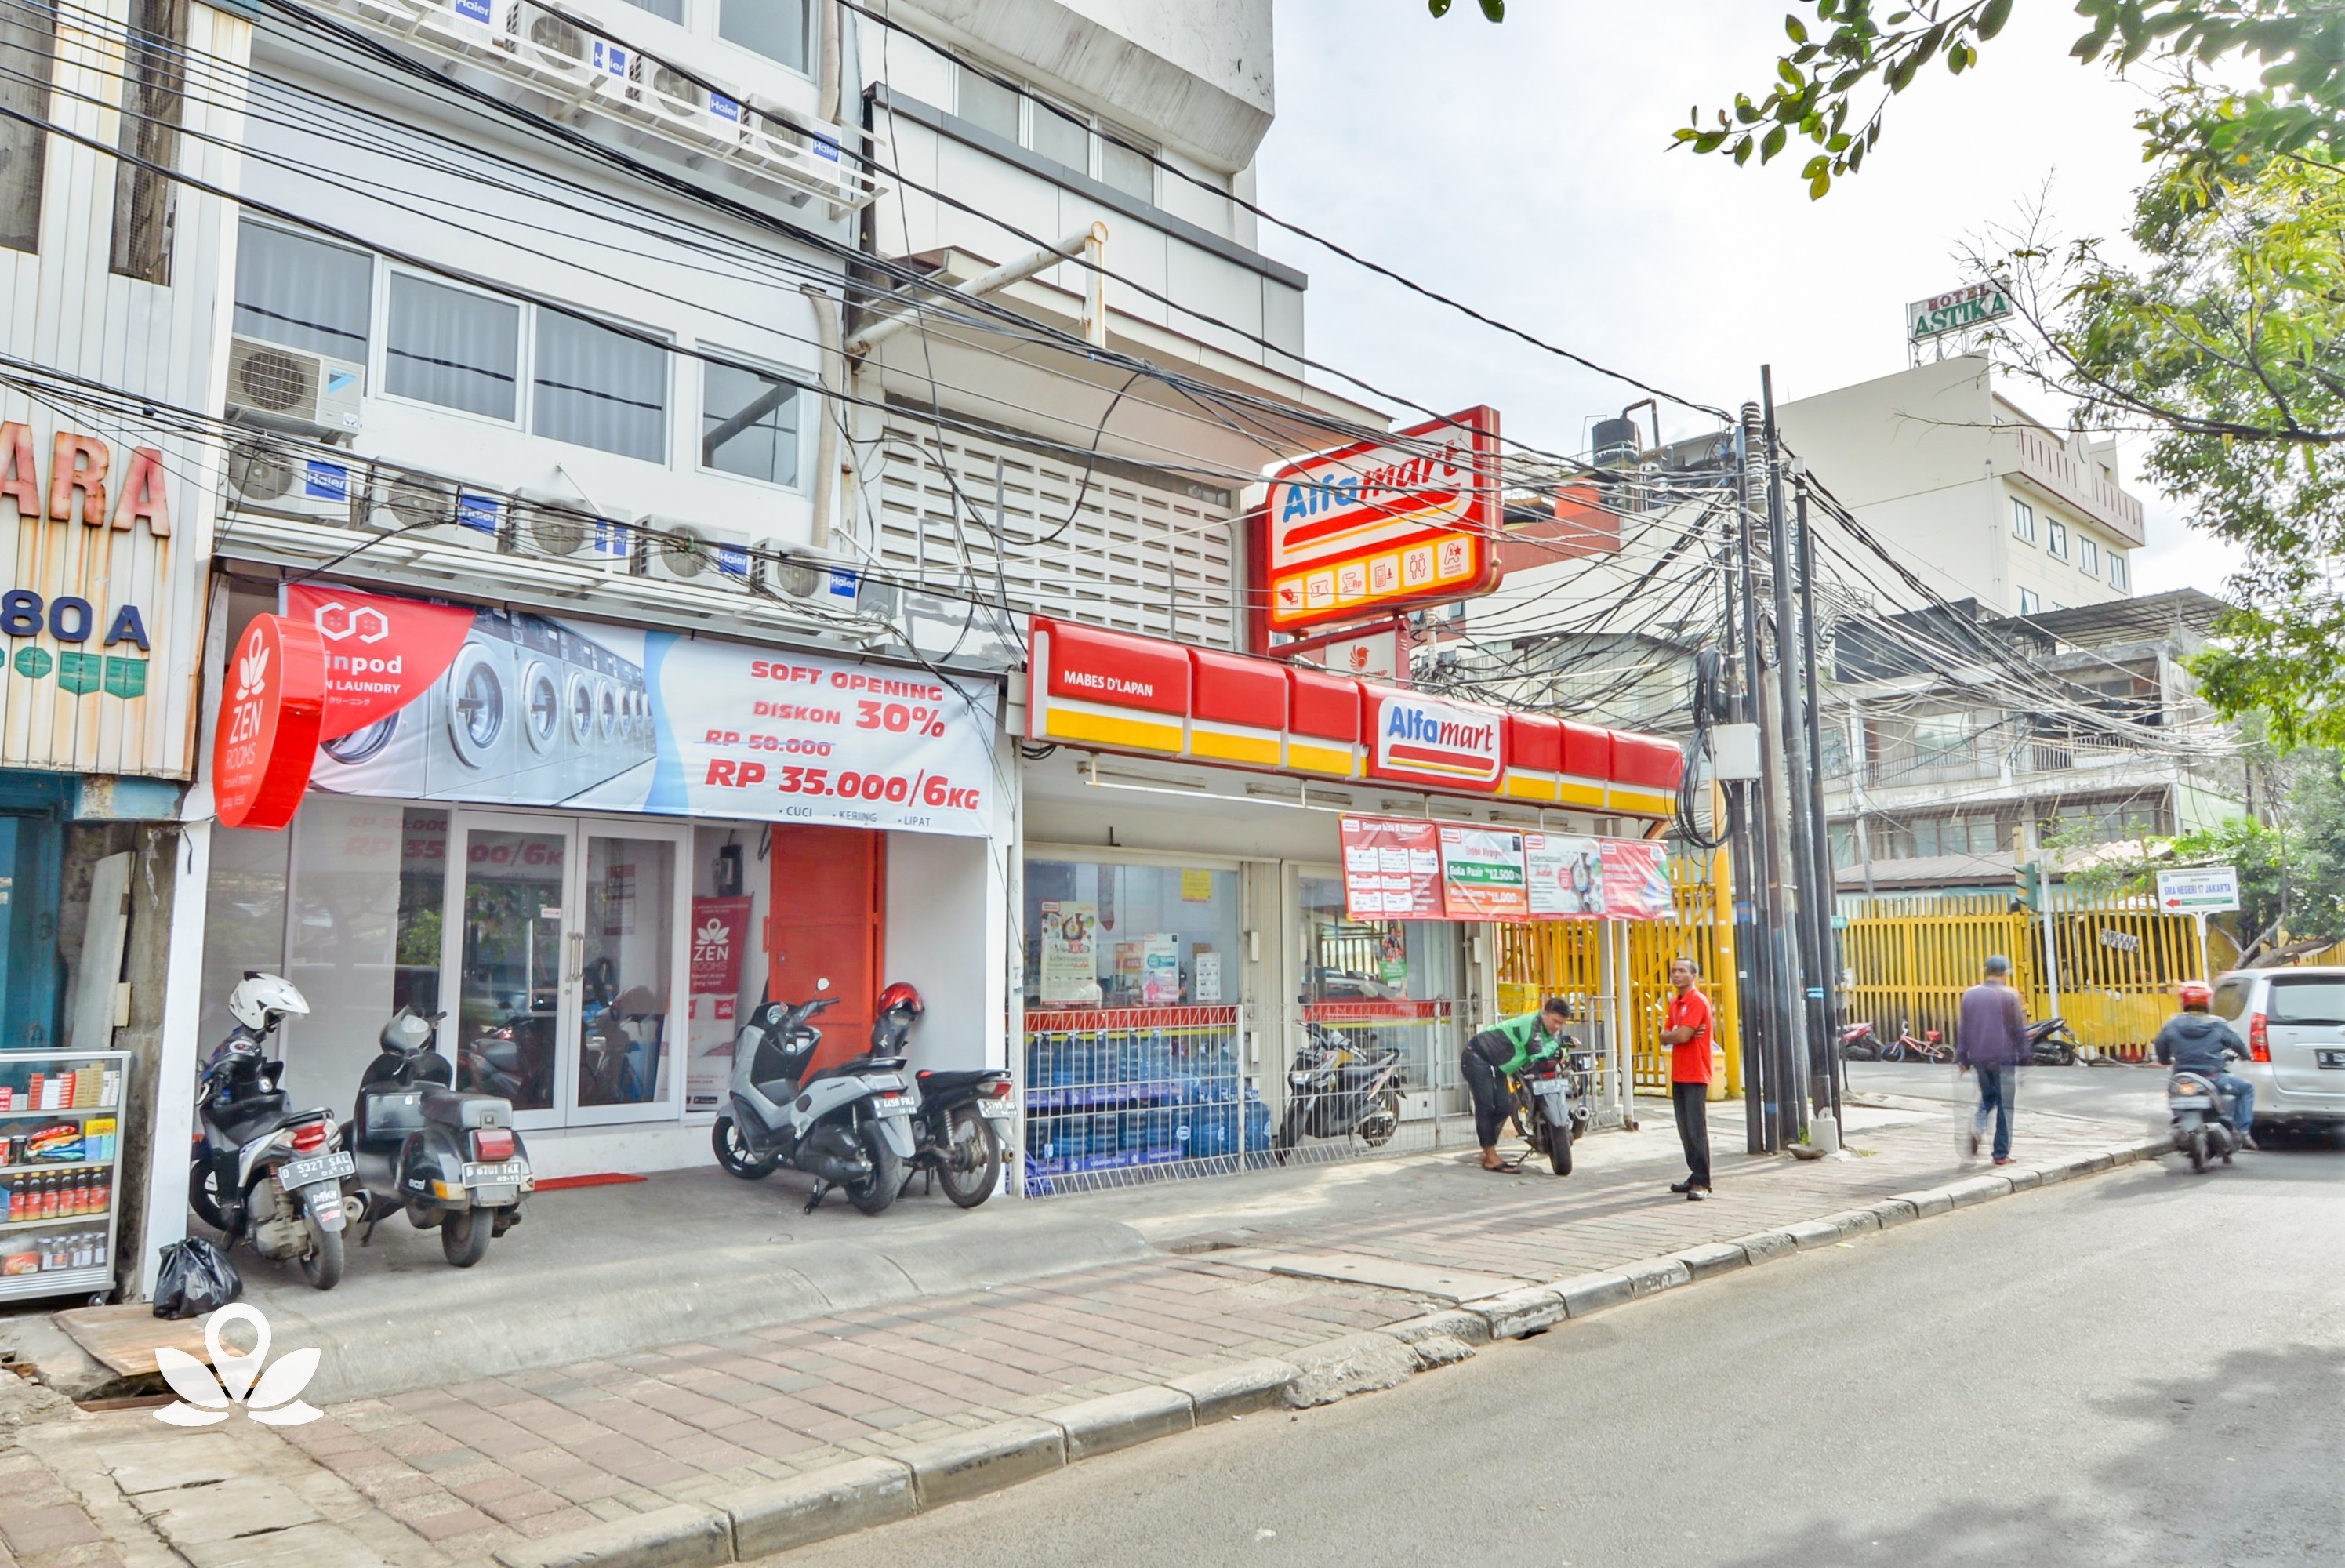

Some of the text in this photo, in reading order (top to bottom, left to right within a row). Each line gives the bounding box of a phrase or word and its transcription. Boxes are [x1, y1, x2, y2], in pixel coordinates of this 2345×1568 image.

[595, 52, 624, 72] Hier
[710, 98, 739, 118] Haier
[813, 140, 839, 157] Haier
[1928, 284, 1990, 311] HOTEL
[1915, 292, 2007, 336] ASTIKA
[307, 472, 346, 489] Haier
[1282, 439, 1461, 524] Alfamart
[720, 552, 746, 566] Haier
[831, 575, 855, 589] Haier
[1352, 579, 1363, 590] Rp
[325, 649, 402, 676] inpod
[336, 680, 401, 695] LAUNDRY
[750, 660, 943, 702] SOFT OPENING
[1064, 670, 1153, 698] MABES D'LAPAN
[228, 698, 264, 745] ZEN
[752, 699, 946, 739] DISKON 30%
[1388, 705, 1494, 752] Alfamart
[704, 729, 832, 757] RP 50.000
[224, 741, 257, 771] ROOMS
[705, 758, 980, 810] RP 35.000/6KG
[786, 807, 931, 828] CUCI KERING LIPAT
[1449, 865, 1465, 877] Gula
[2164, 885, 2176, 895] SMA
[2176, 884, 2198, 895] NEGERI
[2205, 883, 2232, 894] JAKARTA
[693, 945, 729, 962] ZEN
[691, 960, 728, 971] ROOMS
[281, 1154, 350, 1179] D 5327 SAL
[466, 1166, 474, 1177] B
